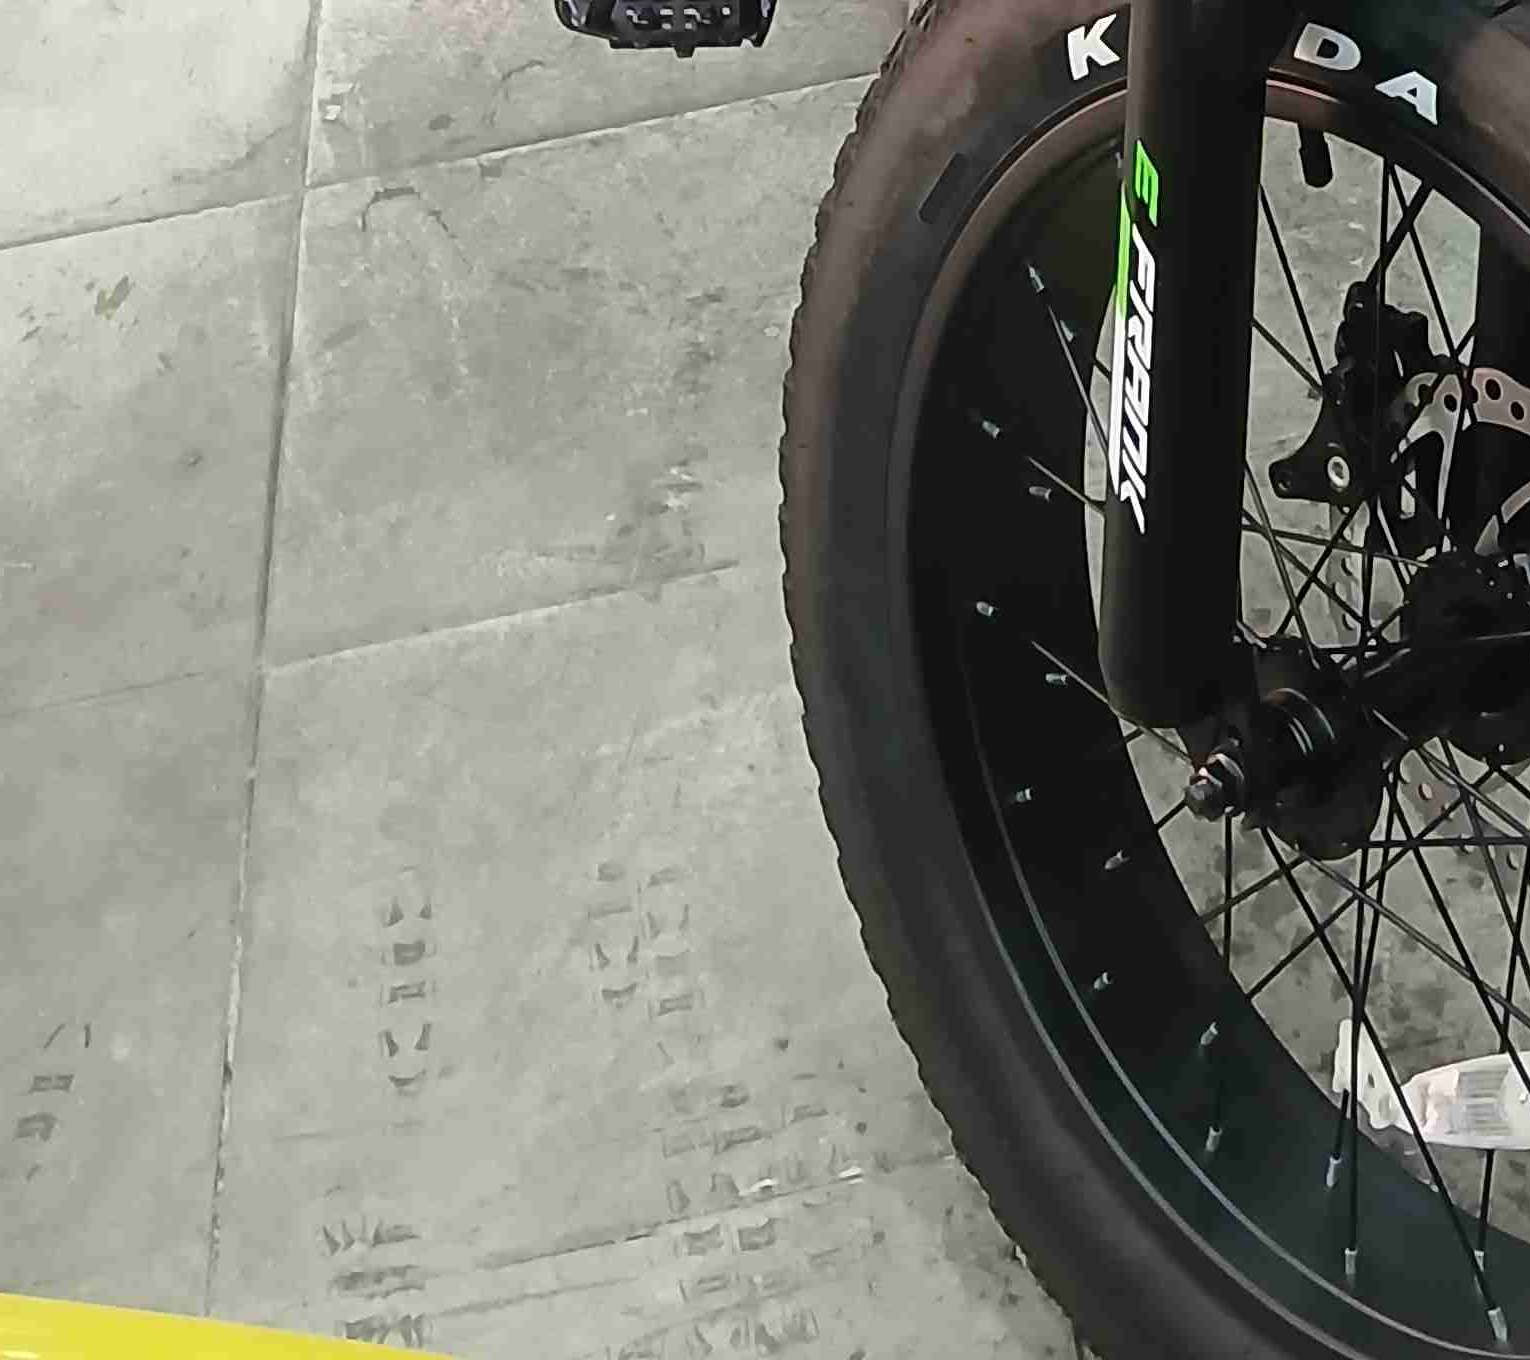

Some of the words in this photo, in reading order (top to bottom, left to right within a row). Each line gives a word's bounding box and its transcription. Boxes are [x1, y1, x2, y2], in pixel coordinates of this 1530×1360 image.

[1066, 13, 1438, 125] KDA
[1134, 139, 1159, 227] E
[1119, 222, 1156, 535] FRANK
